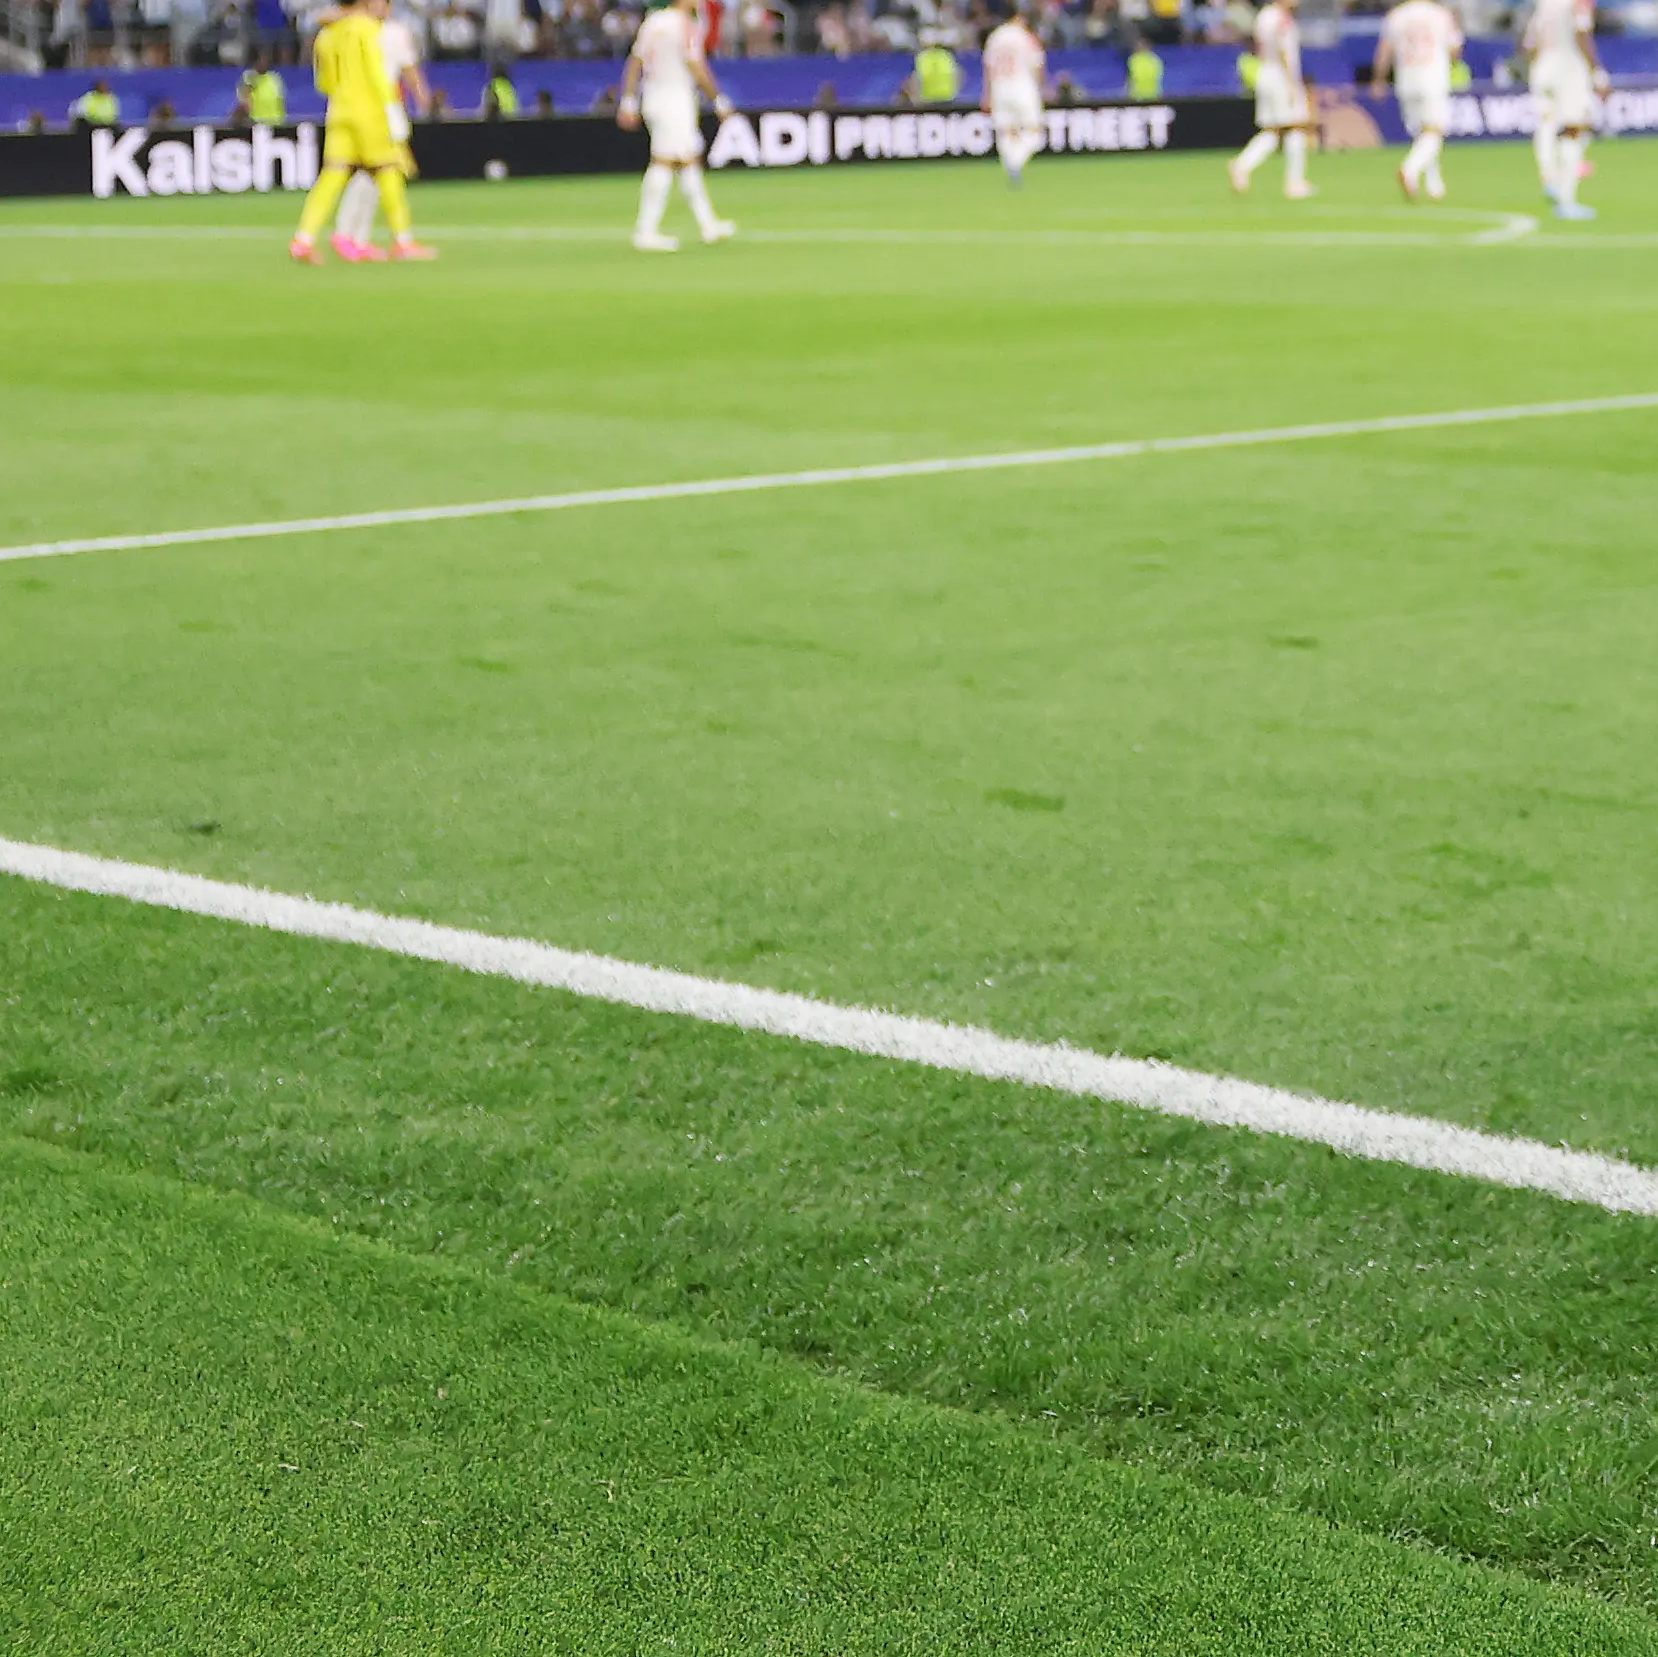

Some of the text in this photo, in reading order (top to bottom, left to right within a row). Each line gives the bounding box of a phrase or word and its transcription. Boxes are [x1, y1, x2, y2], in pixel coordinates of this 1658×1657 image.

[91, 121, 320, 200] Kalshi
[707, 105, 1176, 169] ADI PREDICTREET
